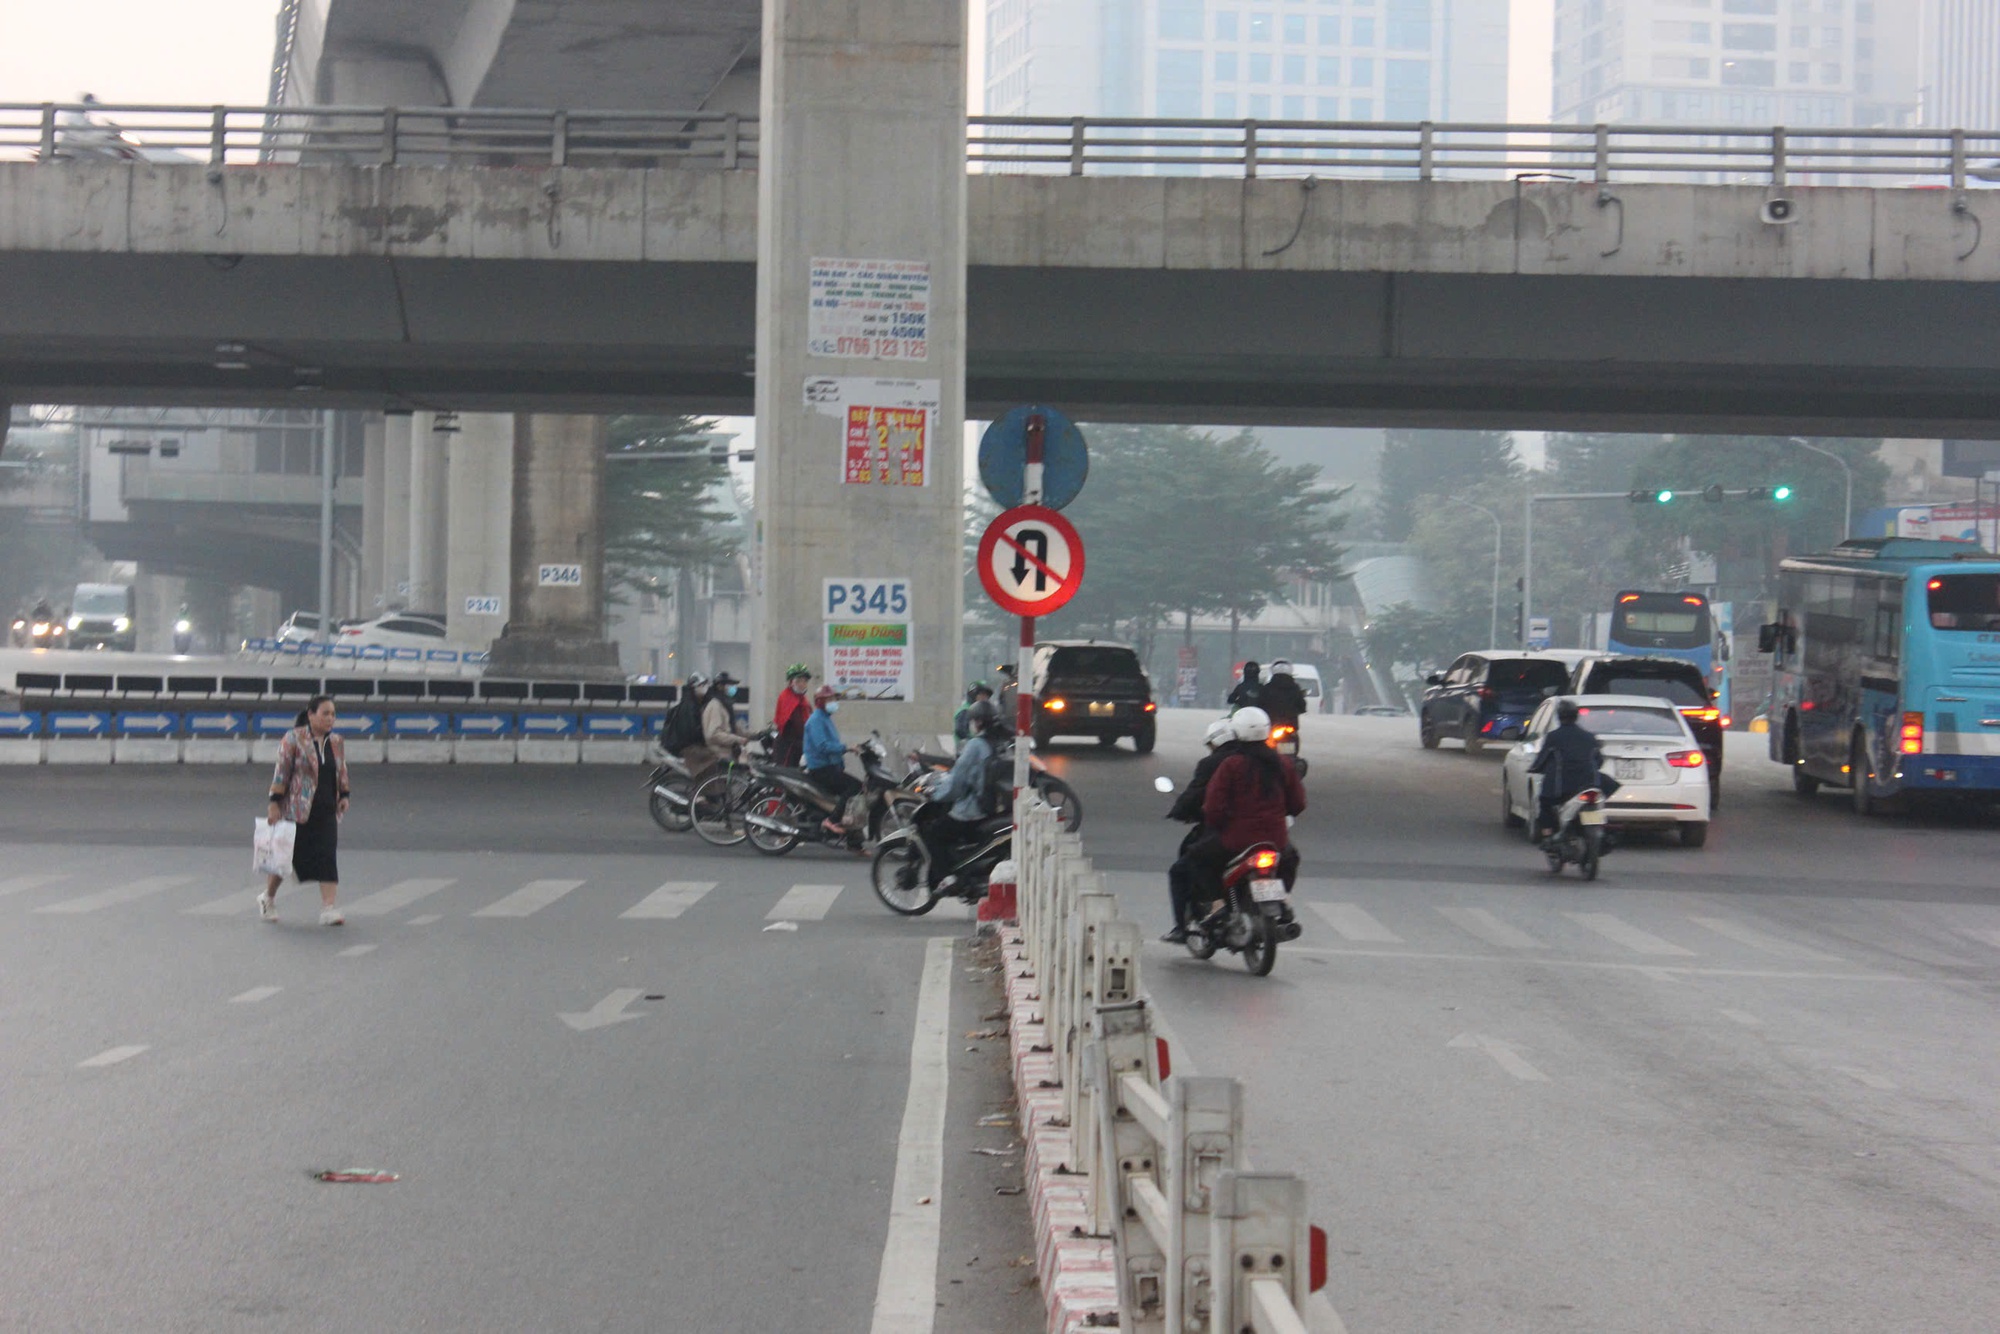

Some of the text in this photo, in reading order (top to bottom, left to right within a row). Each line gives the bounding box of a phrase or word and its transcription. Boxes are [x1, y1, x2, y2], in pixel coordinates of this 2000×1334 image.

[873, 338, 898, 356] 123
[902, 340, 926, 358] 125
[541, 567, 580, 582] P346
[828, 584, 908, 614] P345
